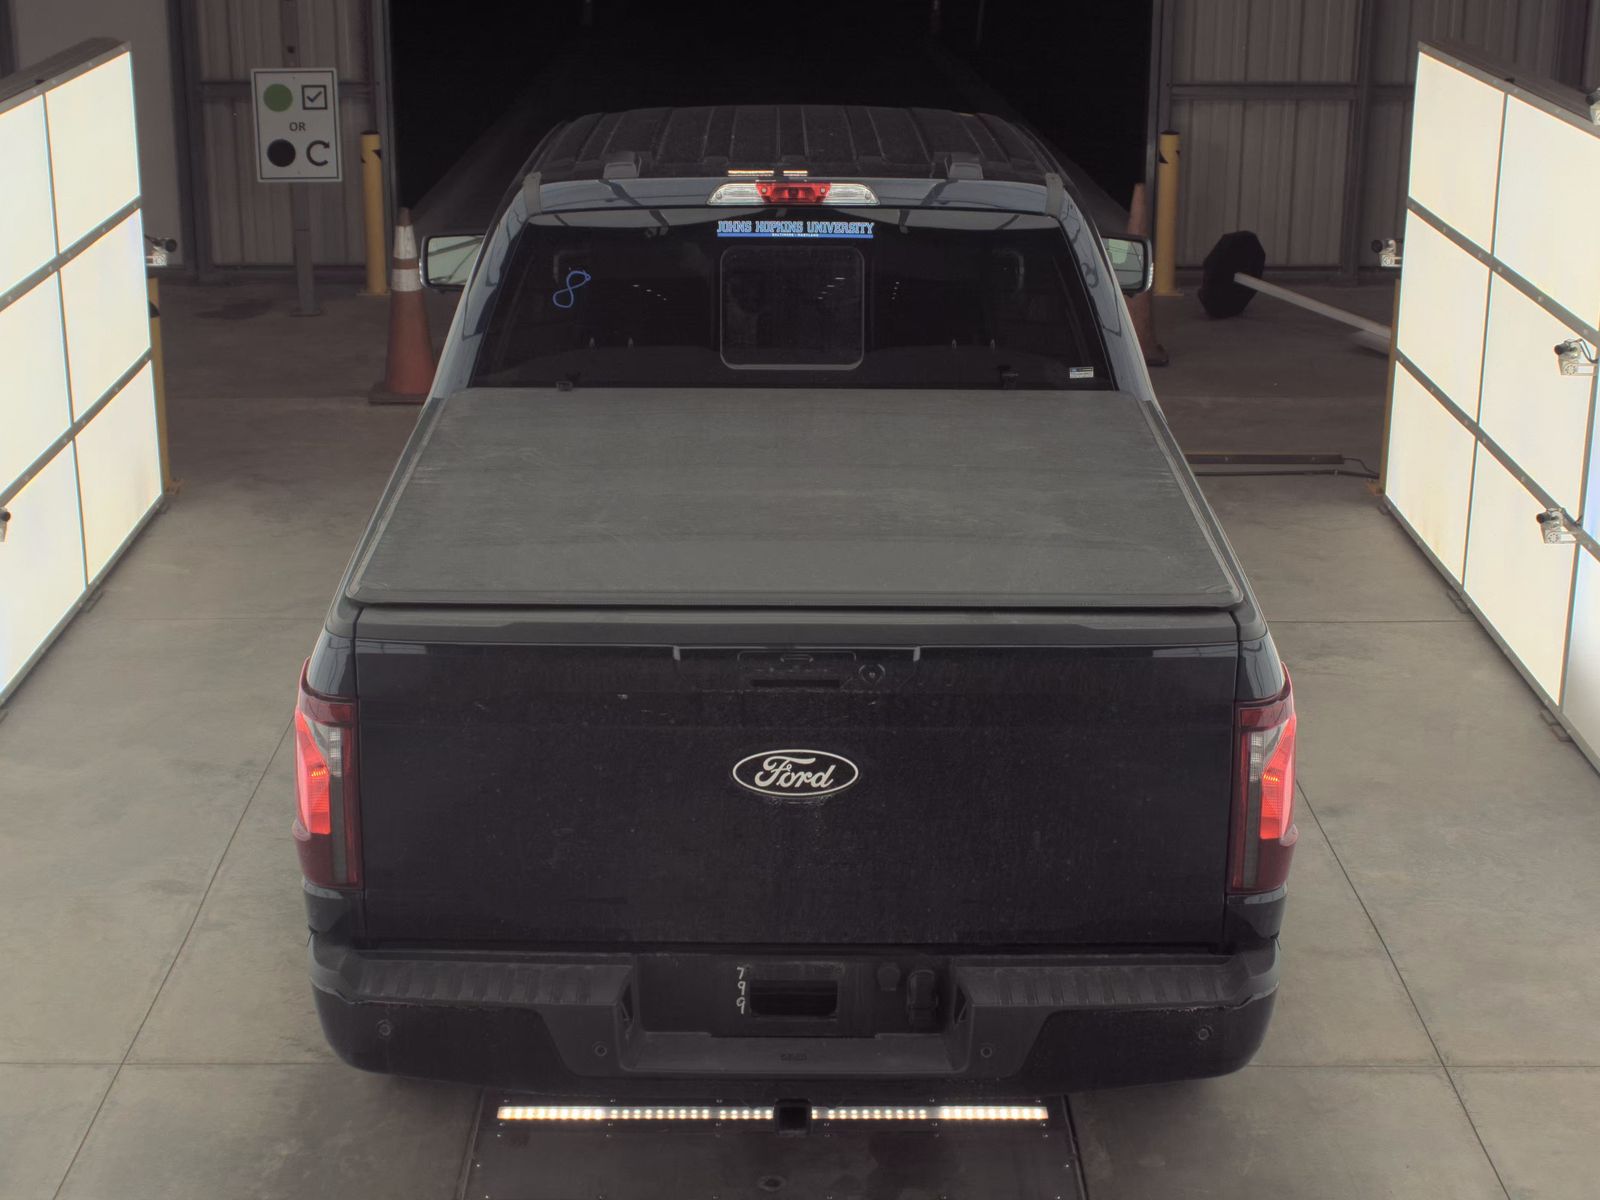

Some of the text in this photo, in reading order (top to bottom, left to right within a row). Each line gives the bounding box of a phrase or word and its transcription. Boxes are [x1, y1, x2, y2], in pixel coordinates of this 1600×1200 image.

[289, 121, 306, 132] OR
[717, 220, 875, 234] JOHNS HOPKINS UNIVERSITY
[754, 755, 837, 788] Ford
[736, 966, 746, 1015] 799
